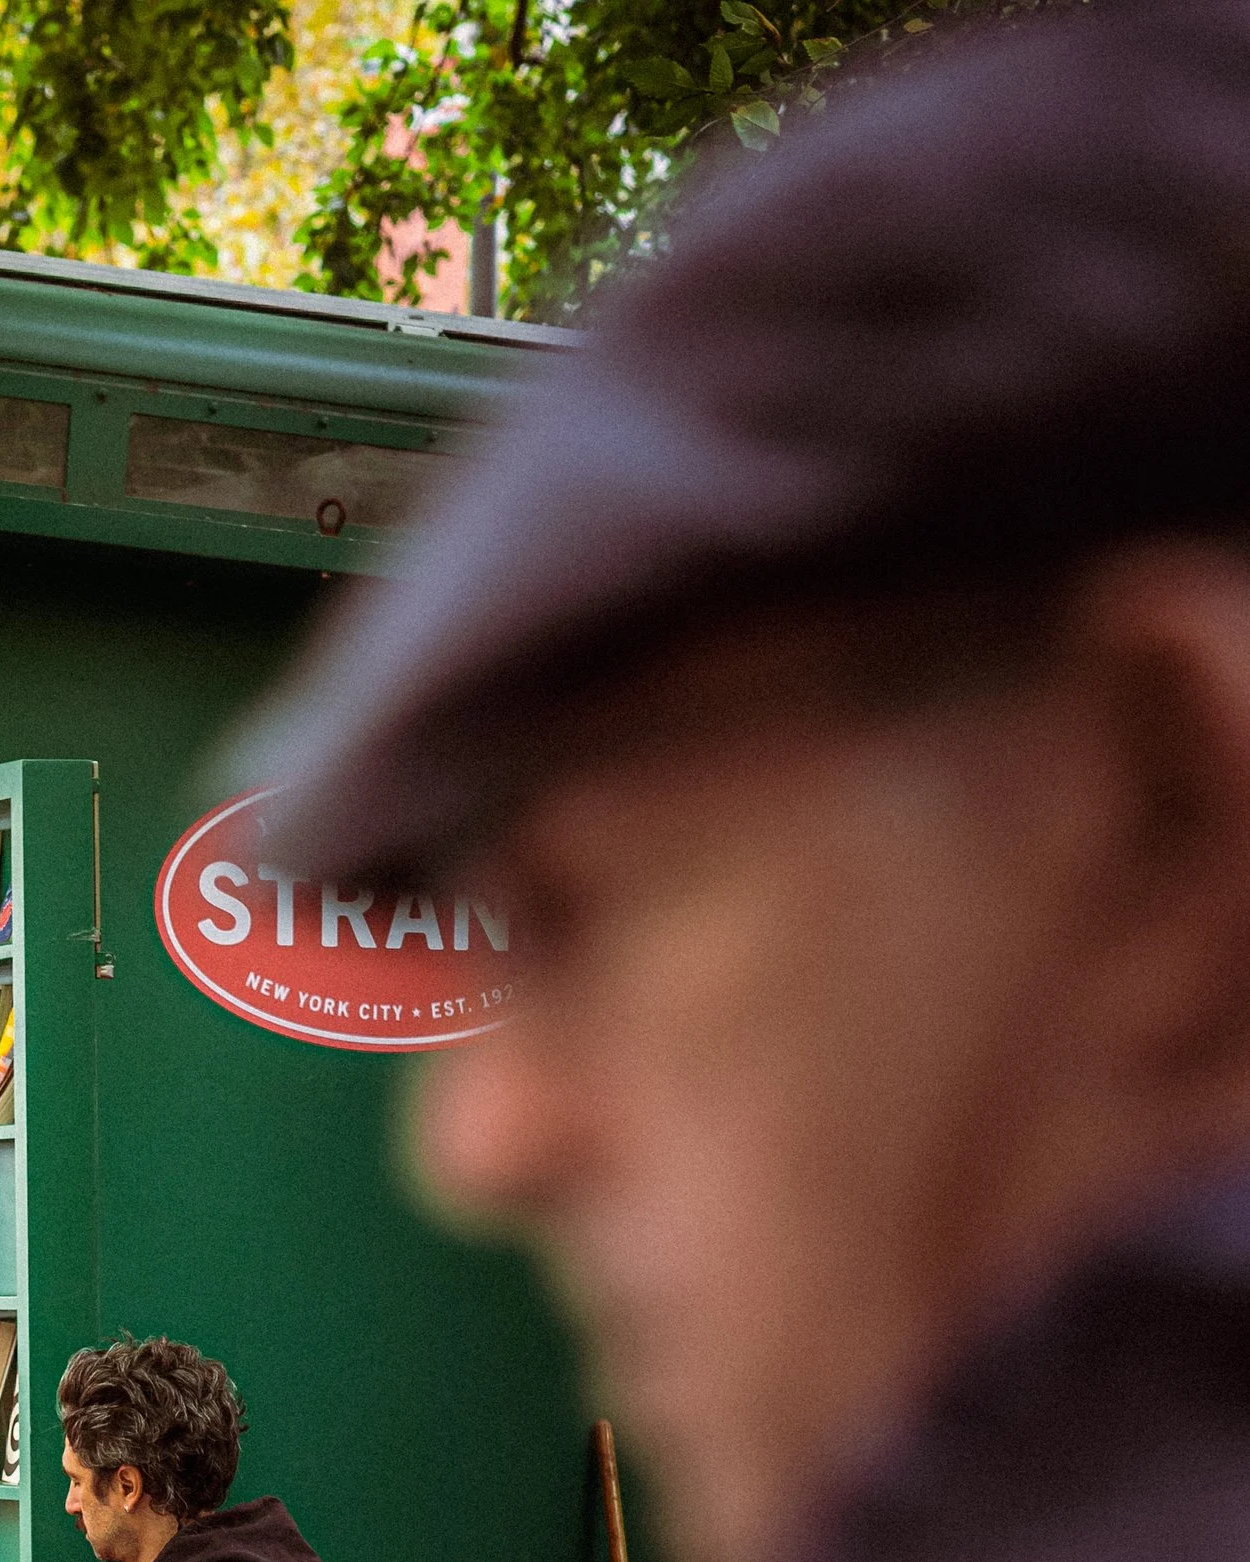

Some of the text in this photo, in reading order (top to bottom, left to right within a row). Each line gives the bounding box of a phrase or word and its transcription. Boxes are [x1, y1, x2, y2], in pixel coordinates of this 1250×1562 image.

[197, 860, 510, 951] STRAN
[245, 971, 519, 1022] NEW YORK CITY EST. 192
